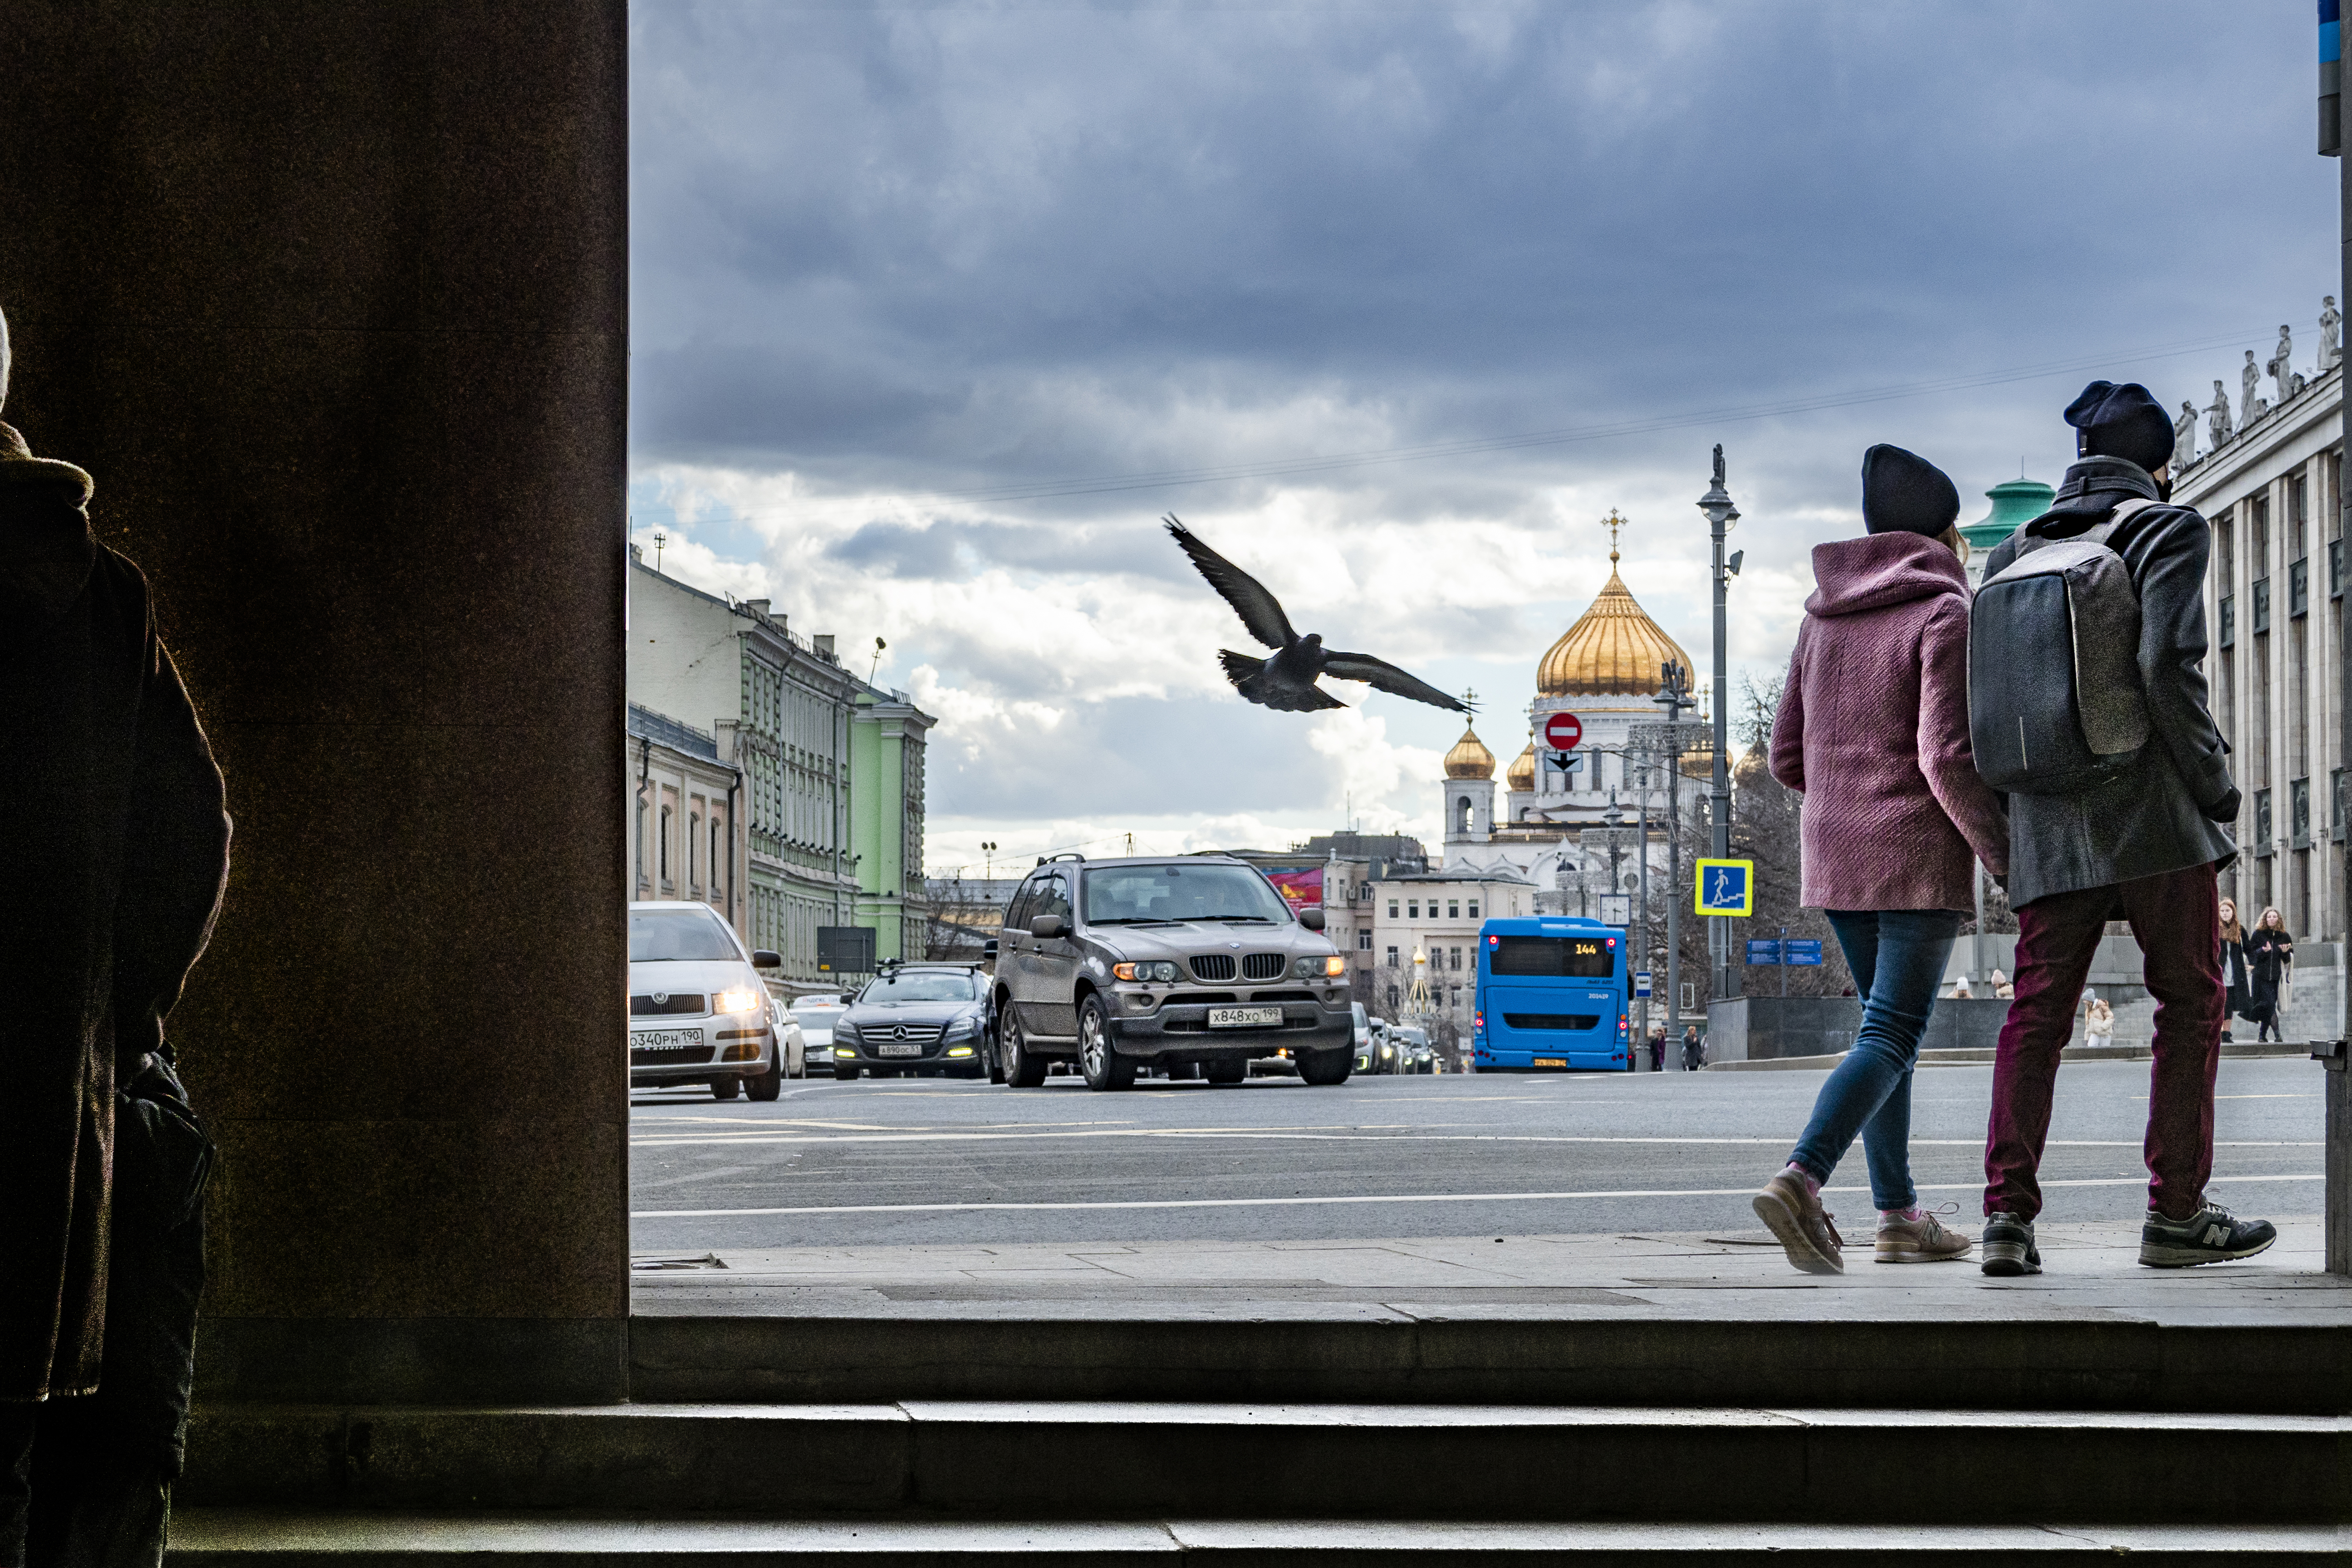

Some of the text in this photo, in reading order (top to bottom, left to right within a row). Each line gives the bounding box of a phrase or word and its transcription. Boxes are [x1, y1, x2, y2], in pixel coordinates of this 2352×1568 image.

[1576, 944, 1596, 954] 144
[1263, 1008, 1278, 1018] 199
[681, 1031, 701, 1041] 190
[2203, 1224, 2231, 1247] N
